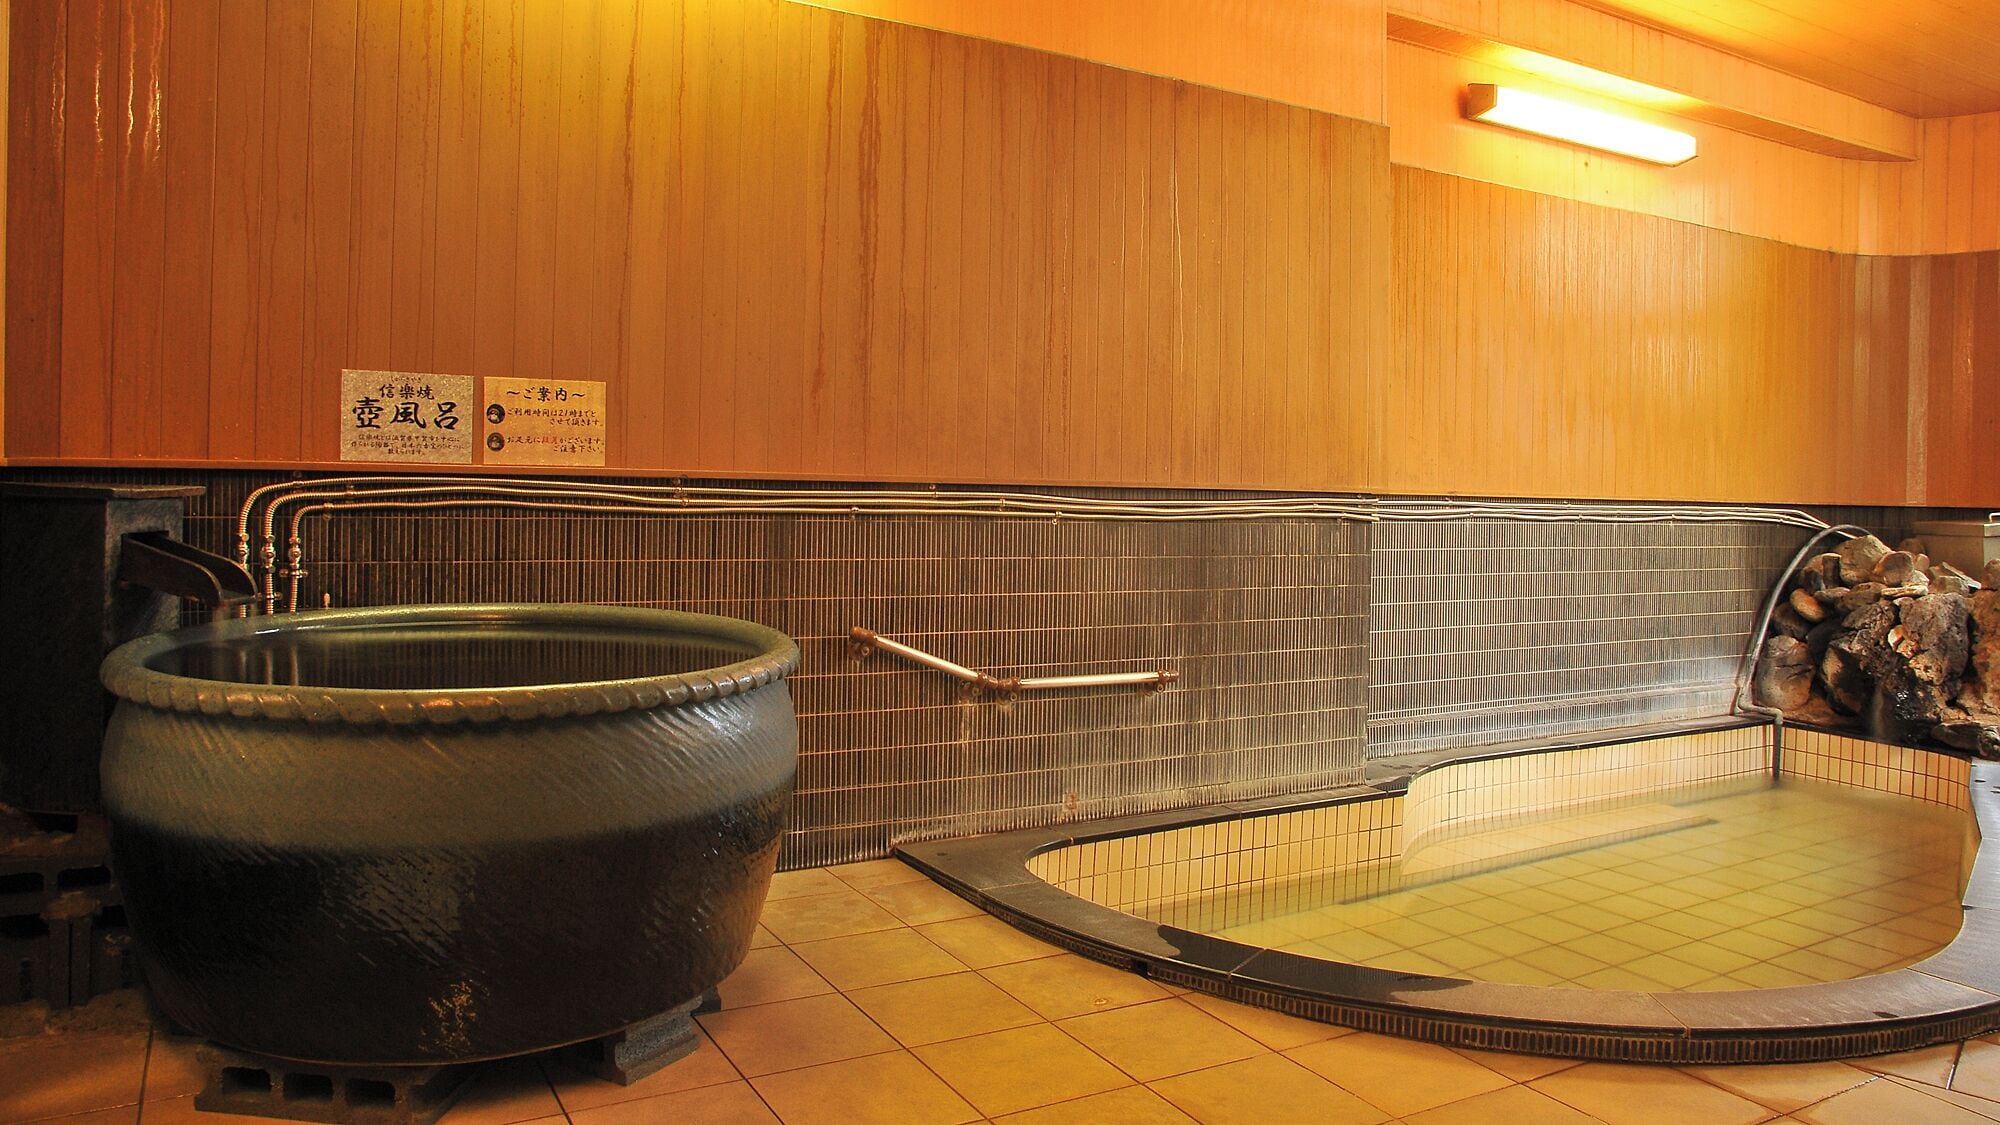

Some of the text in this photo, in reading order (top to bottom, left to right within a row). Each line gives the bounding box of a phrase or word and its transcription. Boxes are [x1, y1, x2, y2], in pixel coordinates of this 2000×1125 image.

[379, 383, 435, 400] 信楽焼
[507, 407, 597, 417] ご利用時間は21時までと
[549, 418, 603, 427] させて頂きます。
[553, 445, 603, 454] ご注意下さい。
